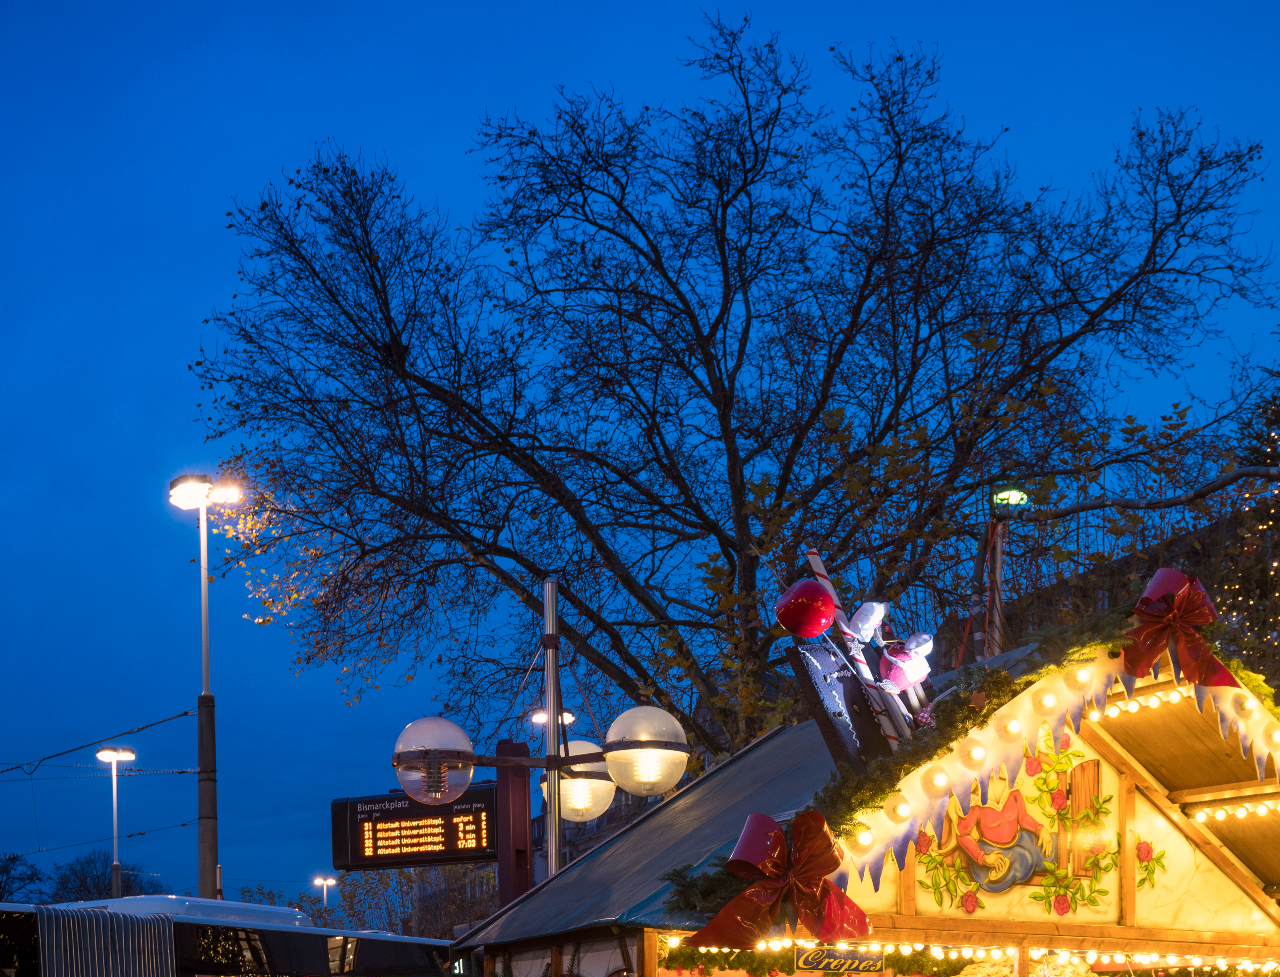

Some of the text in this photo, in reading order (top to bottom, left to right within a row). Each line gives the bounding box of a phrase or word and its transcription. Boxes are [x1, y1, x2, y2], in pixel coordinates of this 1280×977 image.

[357, 800, 409, 812] Bismarckplatz
[364, 812, 487, 831] 31 Altstadt Universitätspl. sofort C
[364, 830, 373, 839] 31
[376, 829, 400, 838] Altstadt
[401, 826, 445, 836] Universitätspl.
[458, 823, 464, 831] 3
[481, 820, 487, 829] C
[364, 839, 373, 847] 32
[377, 838, 401, 847] Altstadt
[401, 834, 445, 845] Universitätspl.
[458, 831, 464, 839] 4
[482, 829, 487, 838] C
[364, 838, 487, 856] 32 Altstadt Universitätspl. 17:03 C
[798, 948, 883, 973] Crepes
